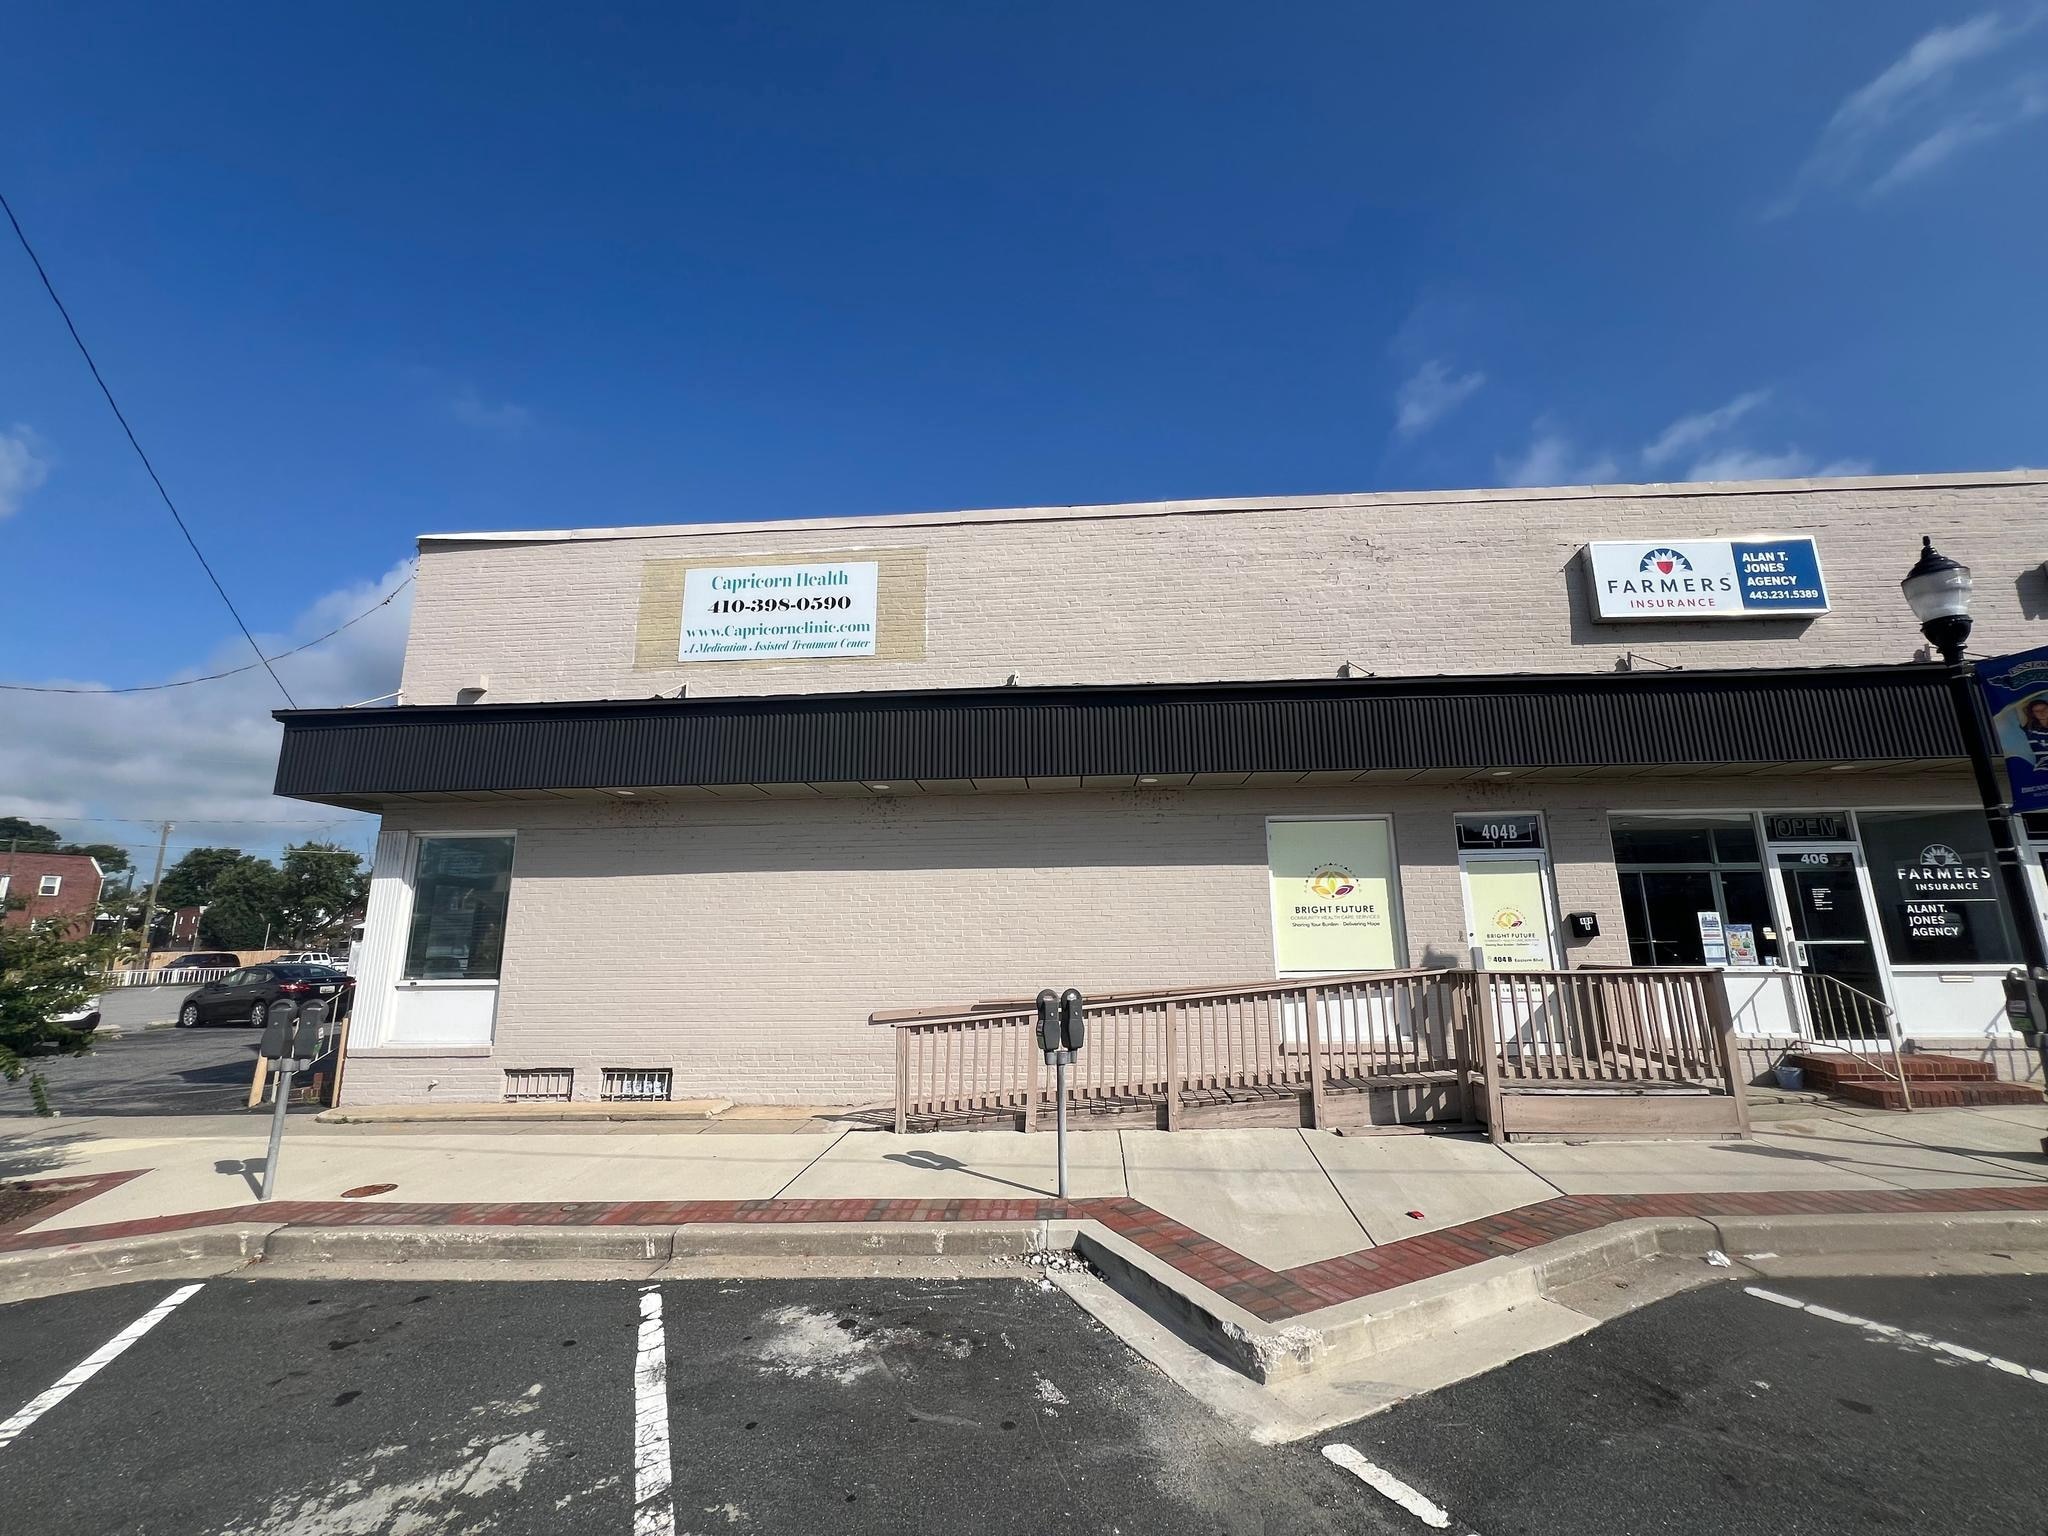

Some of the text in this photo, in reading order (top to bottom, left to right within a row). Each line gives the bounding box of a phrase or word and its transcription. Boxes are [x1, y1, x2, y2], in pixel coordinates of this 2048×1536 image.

[1742, 551, 1789, 562] ALAN T.
[1744, 563, 1785, 573] JONES
[711, 570, 848, 594] Capricorn Health
[1607, 577, 1732, 594] FARMERS
[1747, 576, 1797, 587] AGENCY
[1750, 589, 1819, 600] 443.231.5389
[707, 595, 851, 614] 410-398-0590
[1630, 598, 1716, 609] INSURANCE
[686, 620, 870, 639] www.Capricornclinic.com
[695, 642, 747, 653] Medication
[749, 640, 788, 652] Assisted
[792, 638, 838, 650] Treatment
[840, 638, 871, 648] Center
[1482, 824, 1518, 840] 404B
[1777, 818, 1835, 836] OPEN
[1801, 853, 1829, 864] 406
[1898, 867, 1992, 880] FARMERS
[1915, 882, 1979, 891] INSURANCE
[1295, 905, 1375, 914] BRIGHT FUTURE
[1907, 904, 1948, 914] ALAN T.
[1909, 915, 1945, 926] JONES
[1912, 927, 1959, 937] AGENCY
